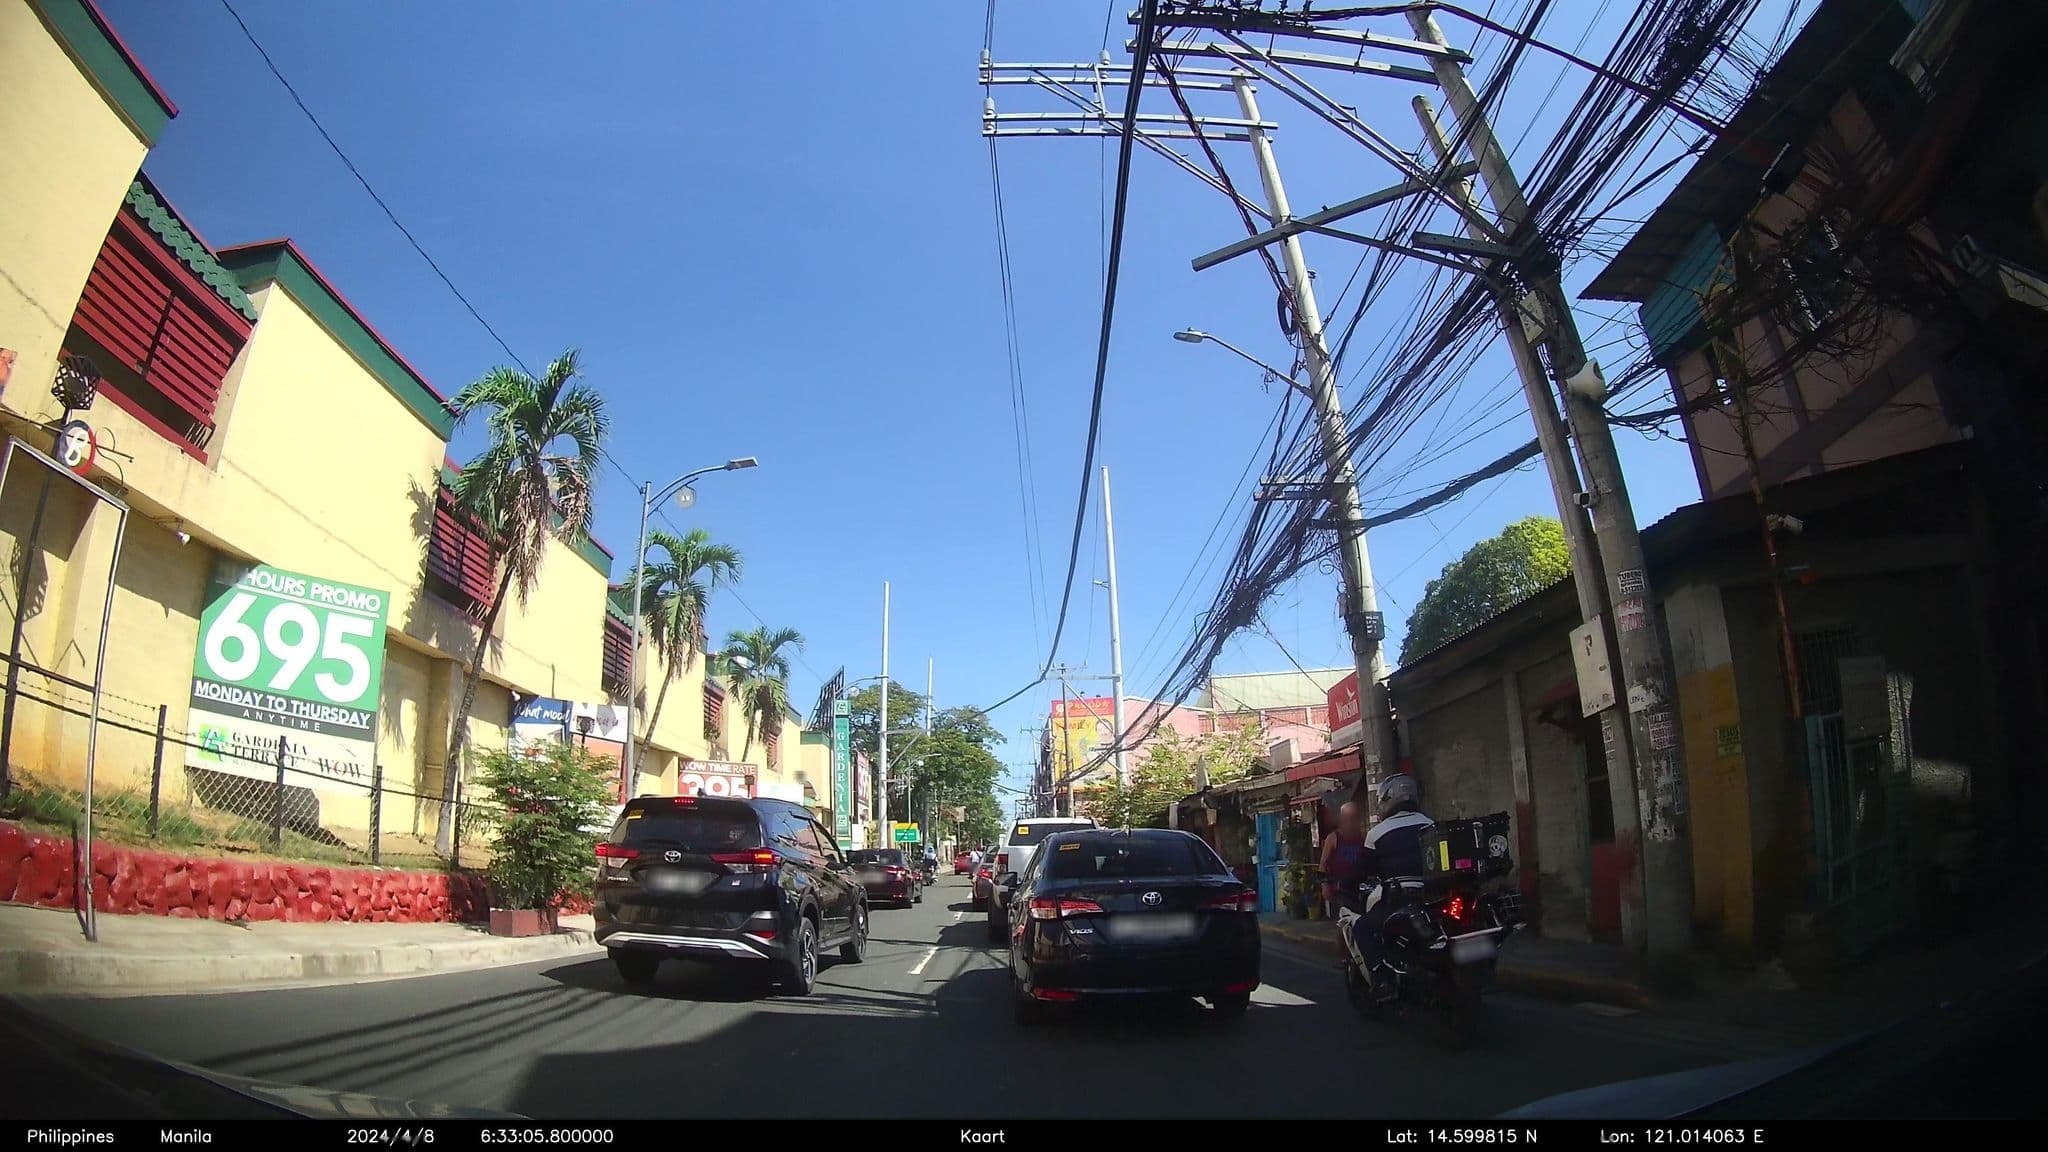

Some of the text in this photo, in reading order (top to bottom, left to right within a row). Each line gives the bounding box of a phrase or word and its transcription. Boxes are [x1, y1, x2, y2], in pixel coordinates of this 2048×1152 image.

[310, 581, 381, 612] PROMO
[204, 592, 375, 703] 695
[194, 680, 371, 727] MONDAY TO THURSDAY
[242, 709, 321, 732] ANYTIME
[318, 756, 362, 779] WOW
[709, 762, 732, 773] TIME
[733, 764, 757, 775] RATE
[836, 731, 847, 813] GARDENIA
